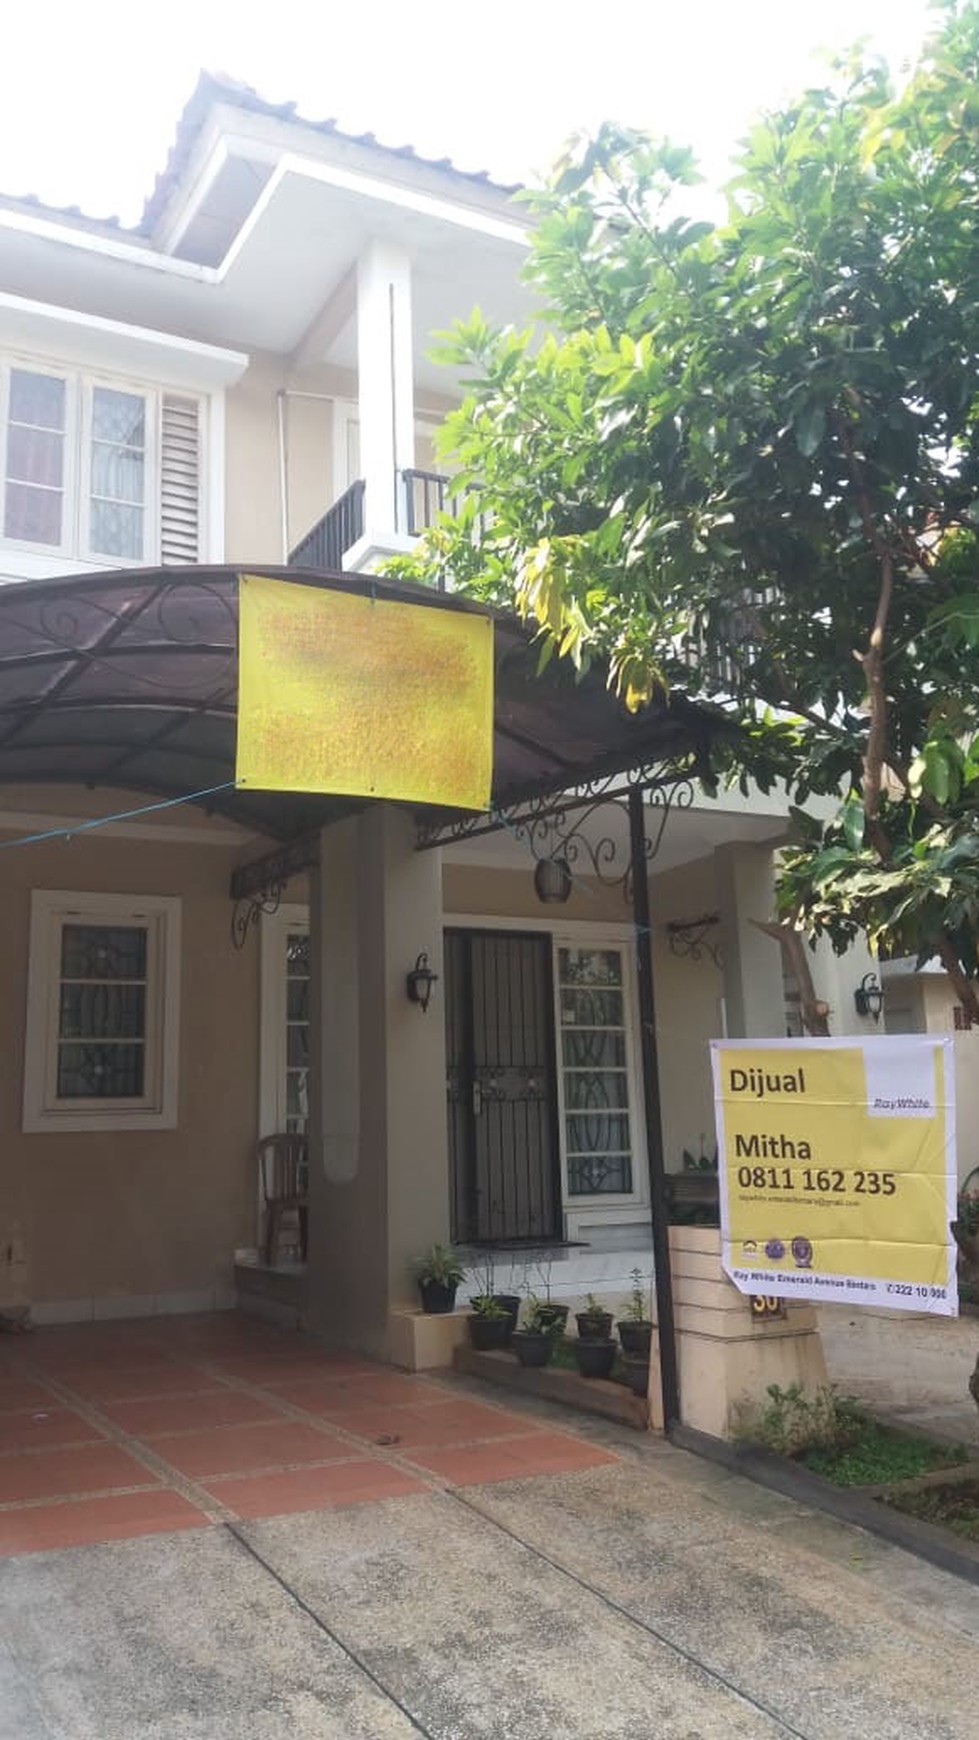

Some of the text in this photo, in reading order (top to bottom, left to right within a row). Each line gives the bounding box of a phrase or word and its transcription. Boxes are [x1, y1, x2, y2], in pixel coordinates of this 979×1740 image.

[730, 1068, 805, 1097] Dijual
[735, 1134, 811, 1160] Mitha
[738, 1166, 896, 1195] 0811 162 235
[733, 1271, 748, 1282] Ray
[777, 1274, 813, 1285] Emerald
[814, 1277, 845, 1288] Avenue
[916, 1286, 928, 1298] 10
